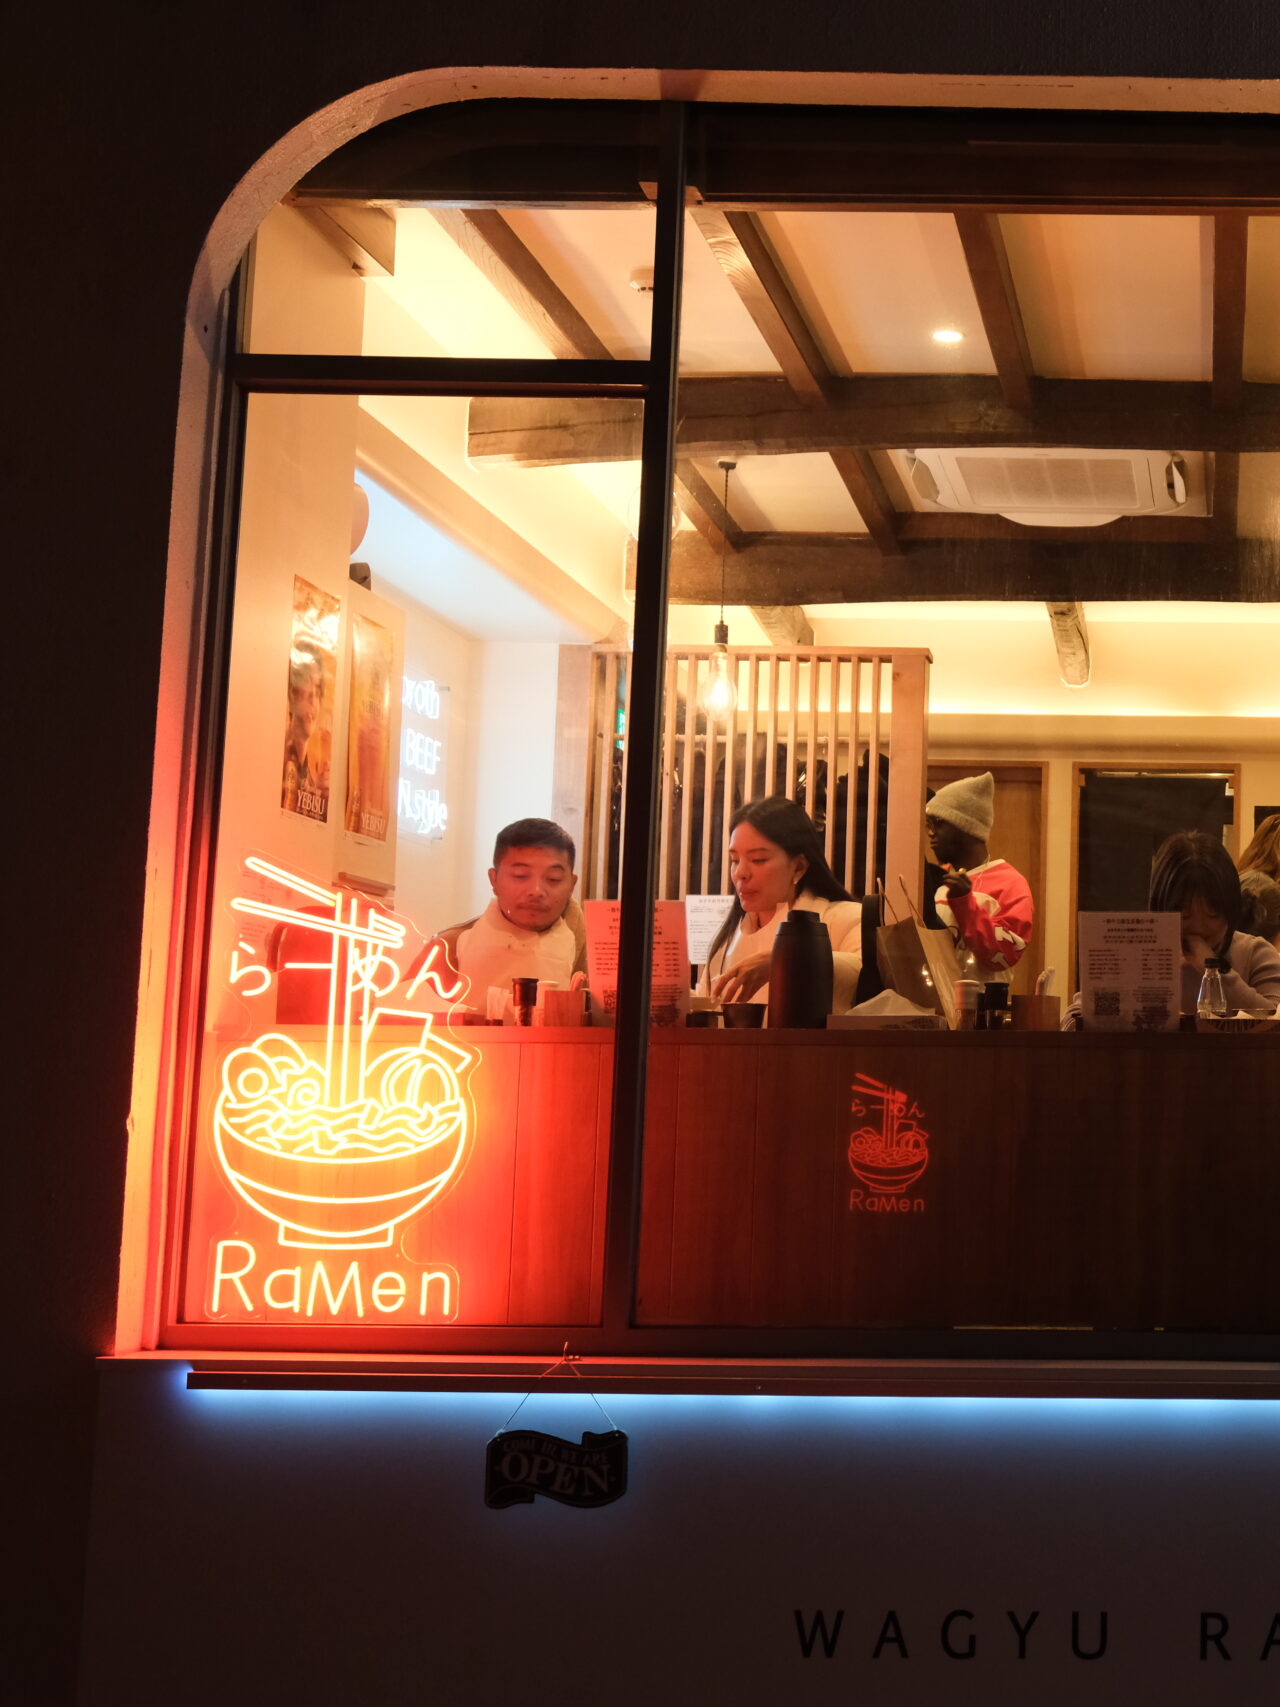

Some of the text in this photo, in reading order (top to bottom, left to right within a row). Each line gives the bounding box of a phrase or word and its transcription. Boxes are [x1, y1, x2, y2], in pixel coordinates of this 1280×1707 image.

[405, 727, 442, 775] BEEF
[297, 789, 326, 815] YEBISU
[361, 811, 386, 834] YEBISU
[230, 941, 463, 1000] らーめん
[849, 1188, 925, 1213] RaMen
[212, 1239, 451, 1317] RaMen
[500, 1452, 611, 1496] OPEN
[794, 1609, 1109, 1660] WAGYU
